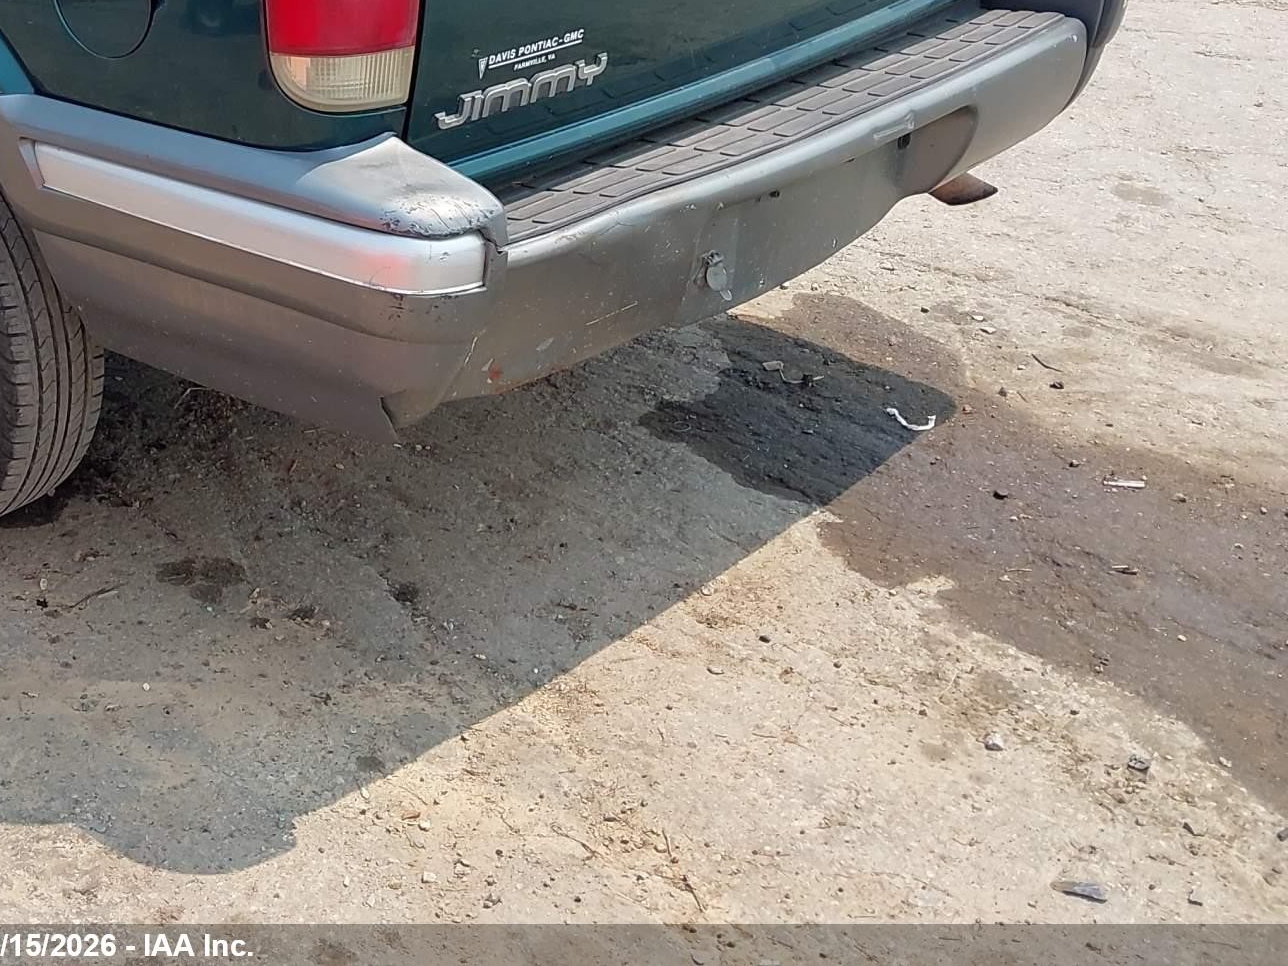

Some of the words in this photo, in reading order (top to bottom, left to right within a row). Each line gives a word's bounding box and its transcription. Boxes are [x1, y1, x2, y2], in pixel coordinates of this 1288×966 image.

[488, 49, 516, 65] DAVIS
[518, 29, 585, 56] PONTIAC-GMC
[548, 53, 556, 61] VA
